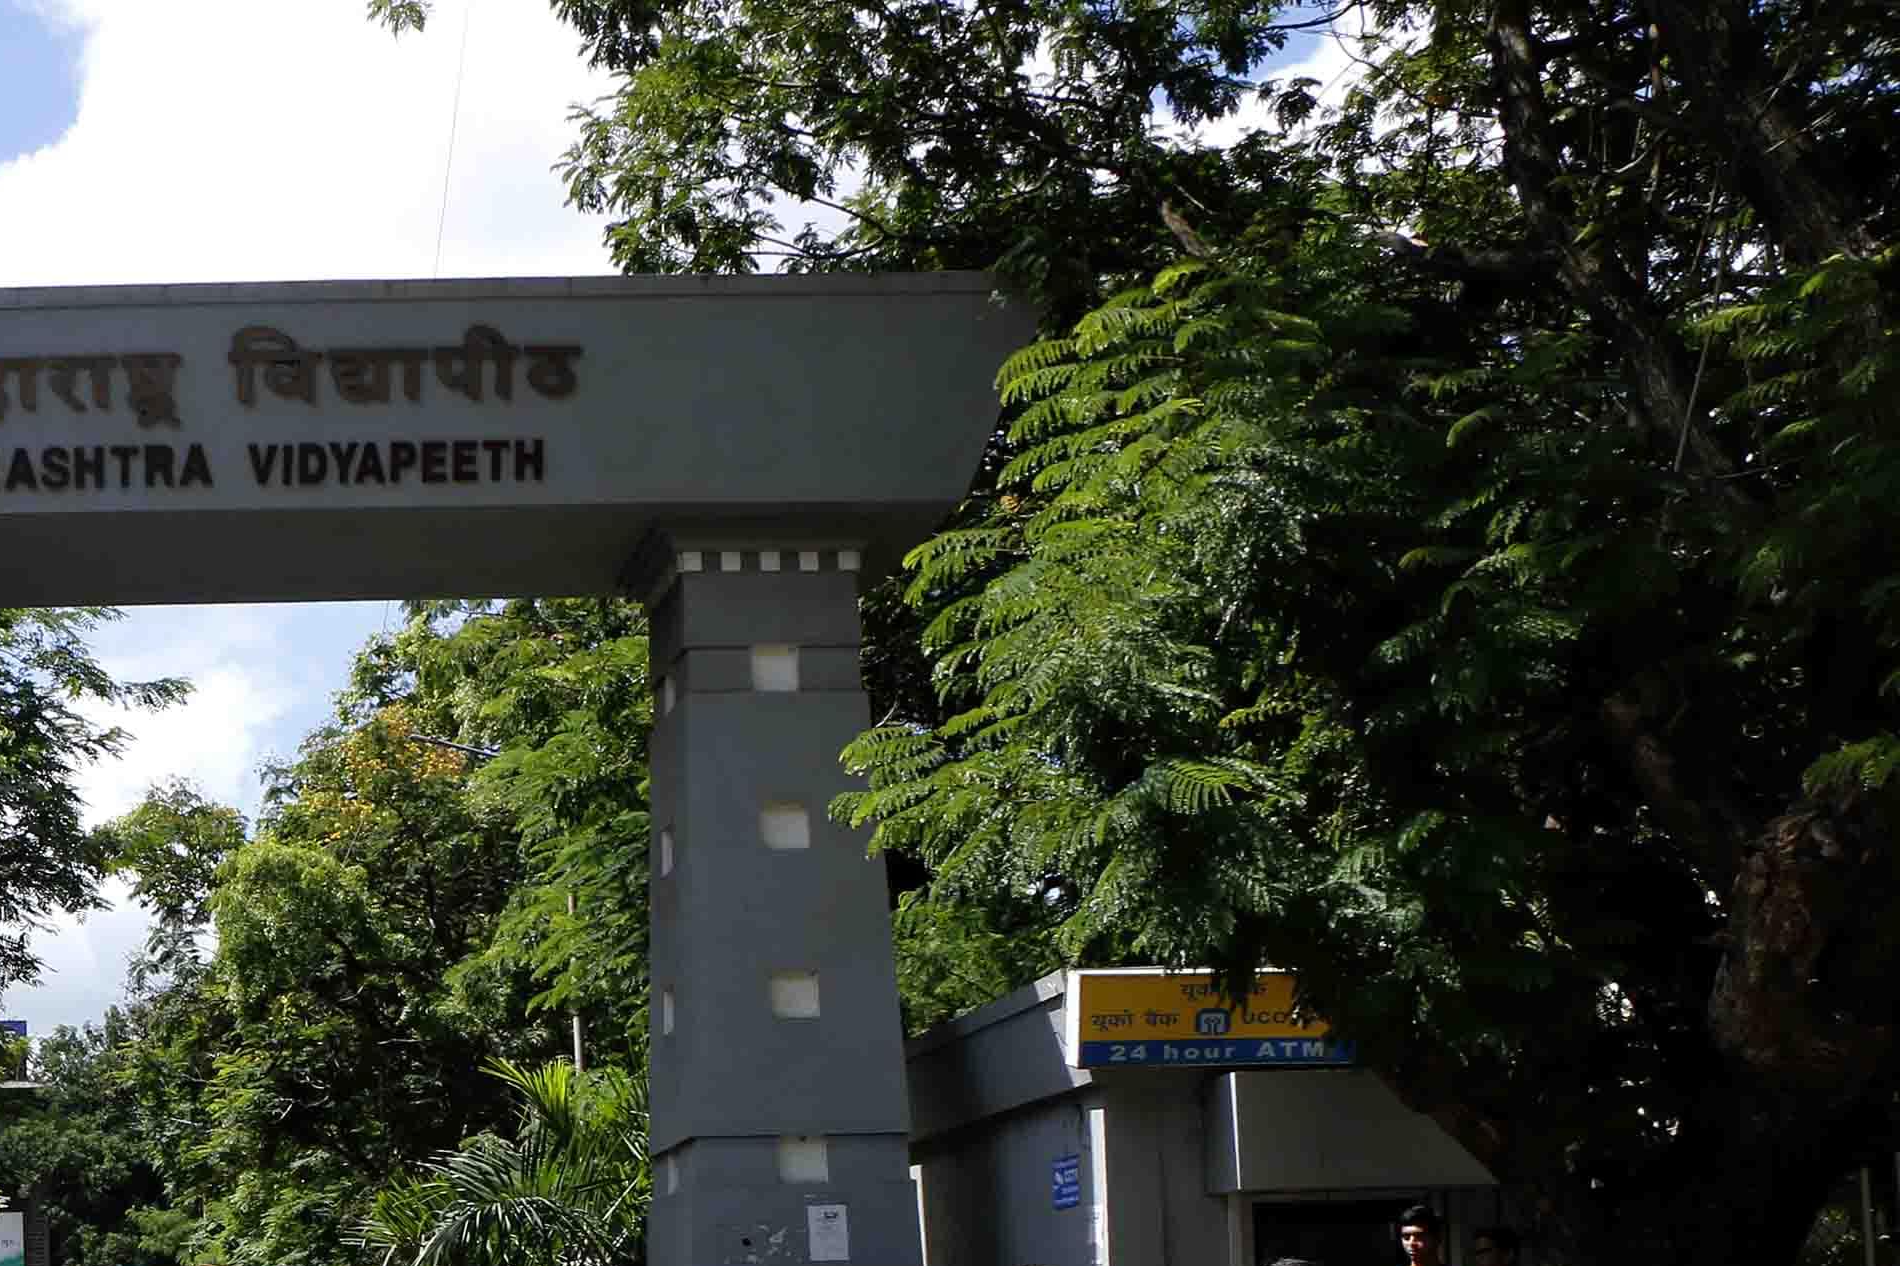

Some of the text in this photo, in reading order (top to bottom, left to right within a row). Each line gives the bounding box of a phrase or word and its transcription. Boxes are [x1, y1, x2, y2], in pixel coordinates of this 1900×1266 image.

[227, 323, 585, 408] विद्यापीठ
[247, 438, 546, 487] VIDYAPEETH
[1109, 1041, 1325, 1062] 24 hour ATM
